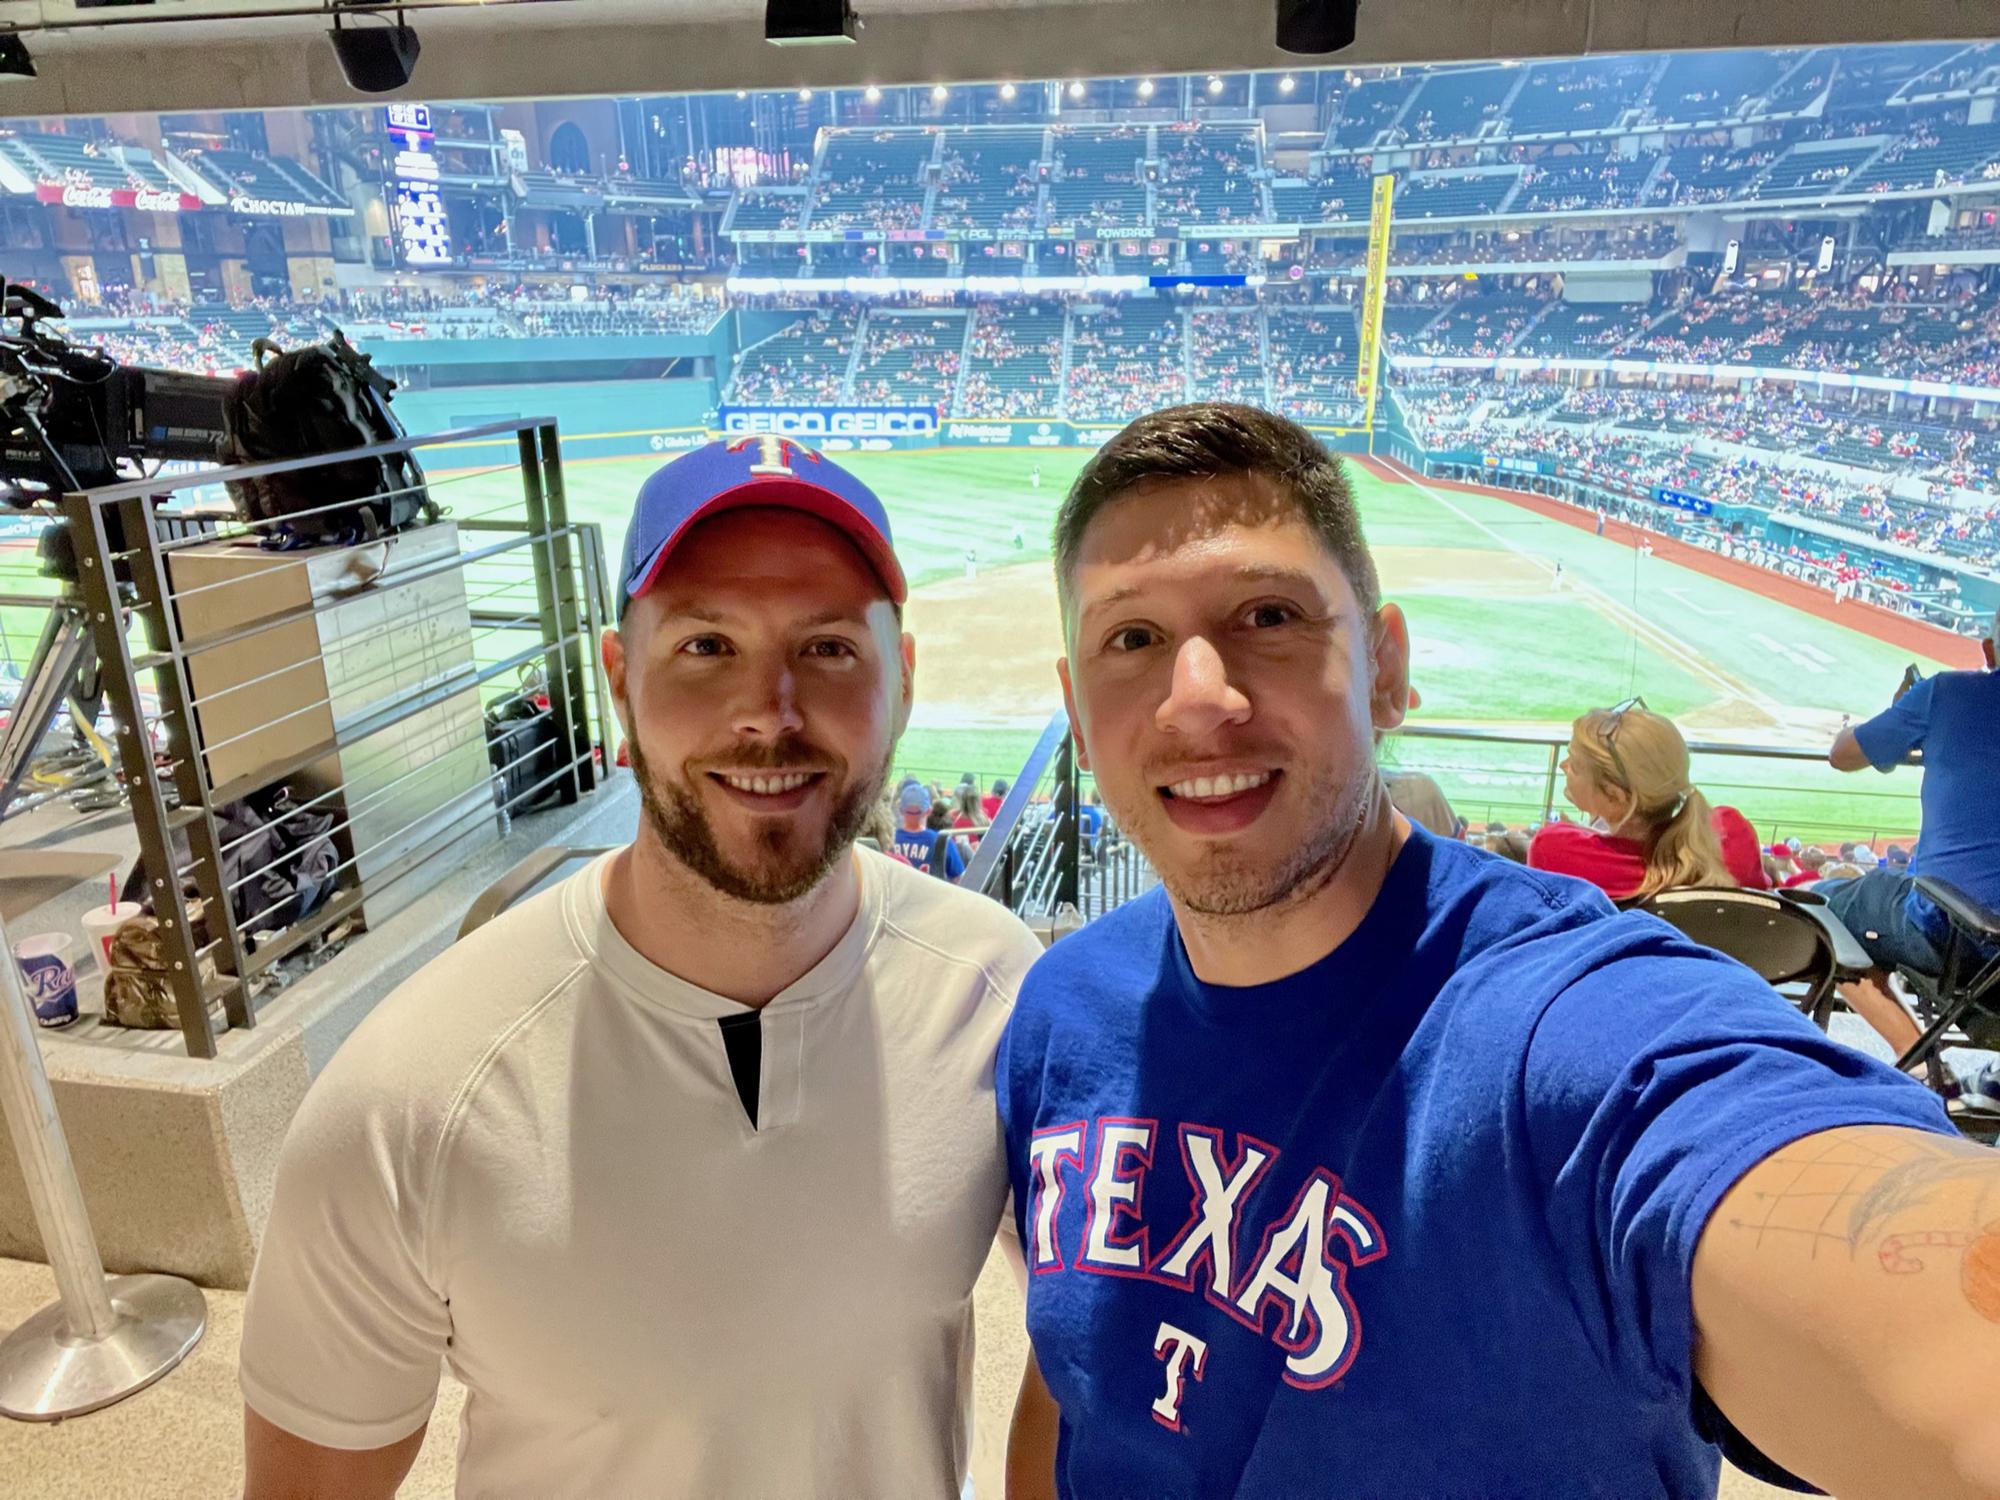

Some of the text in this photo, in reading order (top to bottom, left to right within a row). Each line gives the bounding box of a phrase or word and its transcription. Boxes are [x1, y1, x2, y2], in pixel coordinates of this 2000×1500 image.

[238, 197, 305, 214] CHOCTAW
[1096, 228, 1156, 239] POWERADE
[725, 412, 932, 433] GEICO GEICO
[894, 843, 929, 860] RYAN
[1026, 1116, 1388, 1391] TEXAS
[1151, 1321, 1208, 1433] T
